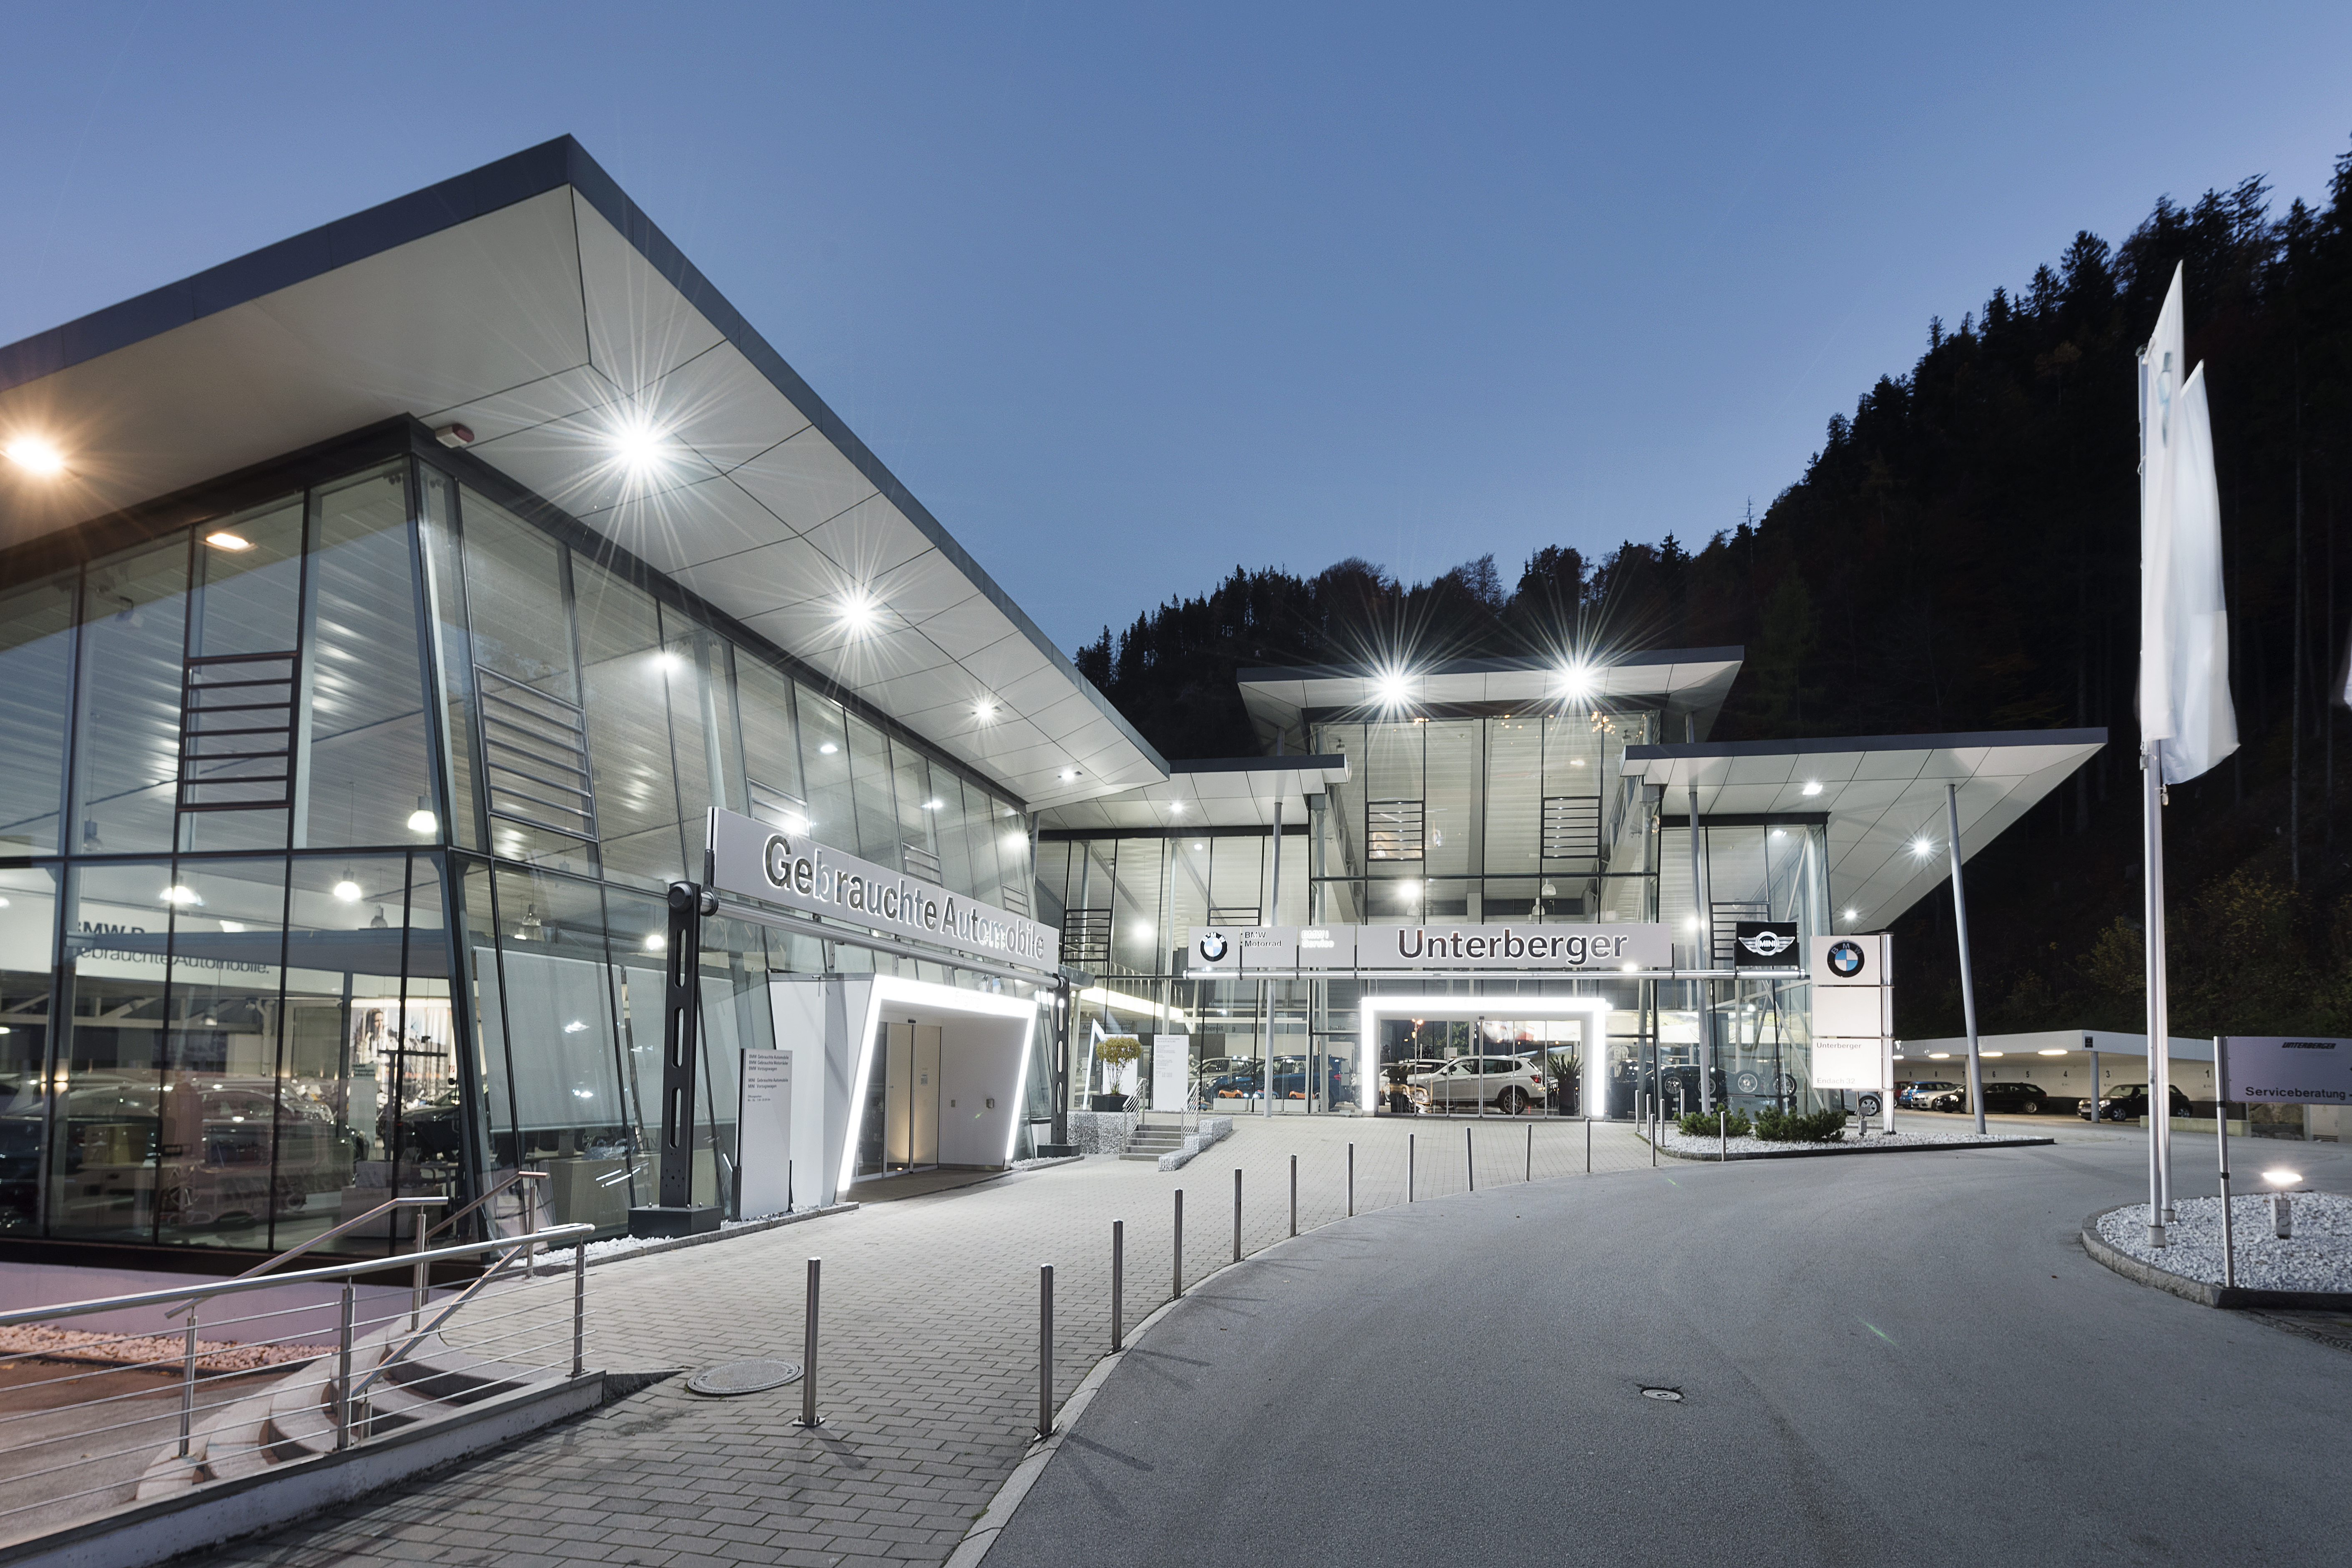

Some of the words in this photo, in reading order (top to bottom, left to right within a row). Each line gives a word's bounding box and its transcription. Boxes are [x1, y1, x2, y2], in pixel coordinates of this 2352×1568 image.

[762, 833, 937, 932] Gebrauchte
[940, 896, 1044, 961] Automobile
[1301, 930, 1324, 938] BMW
[1301, 939, 1335, 948] Service
[1398, 929, 1628, 965] Unterberger
[2205, 1069, 2209, 1078] 1
[2245, 1087, 2346, 1100] Serviceberatung
